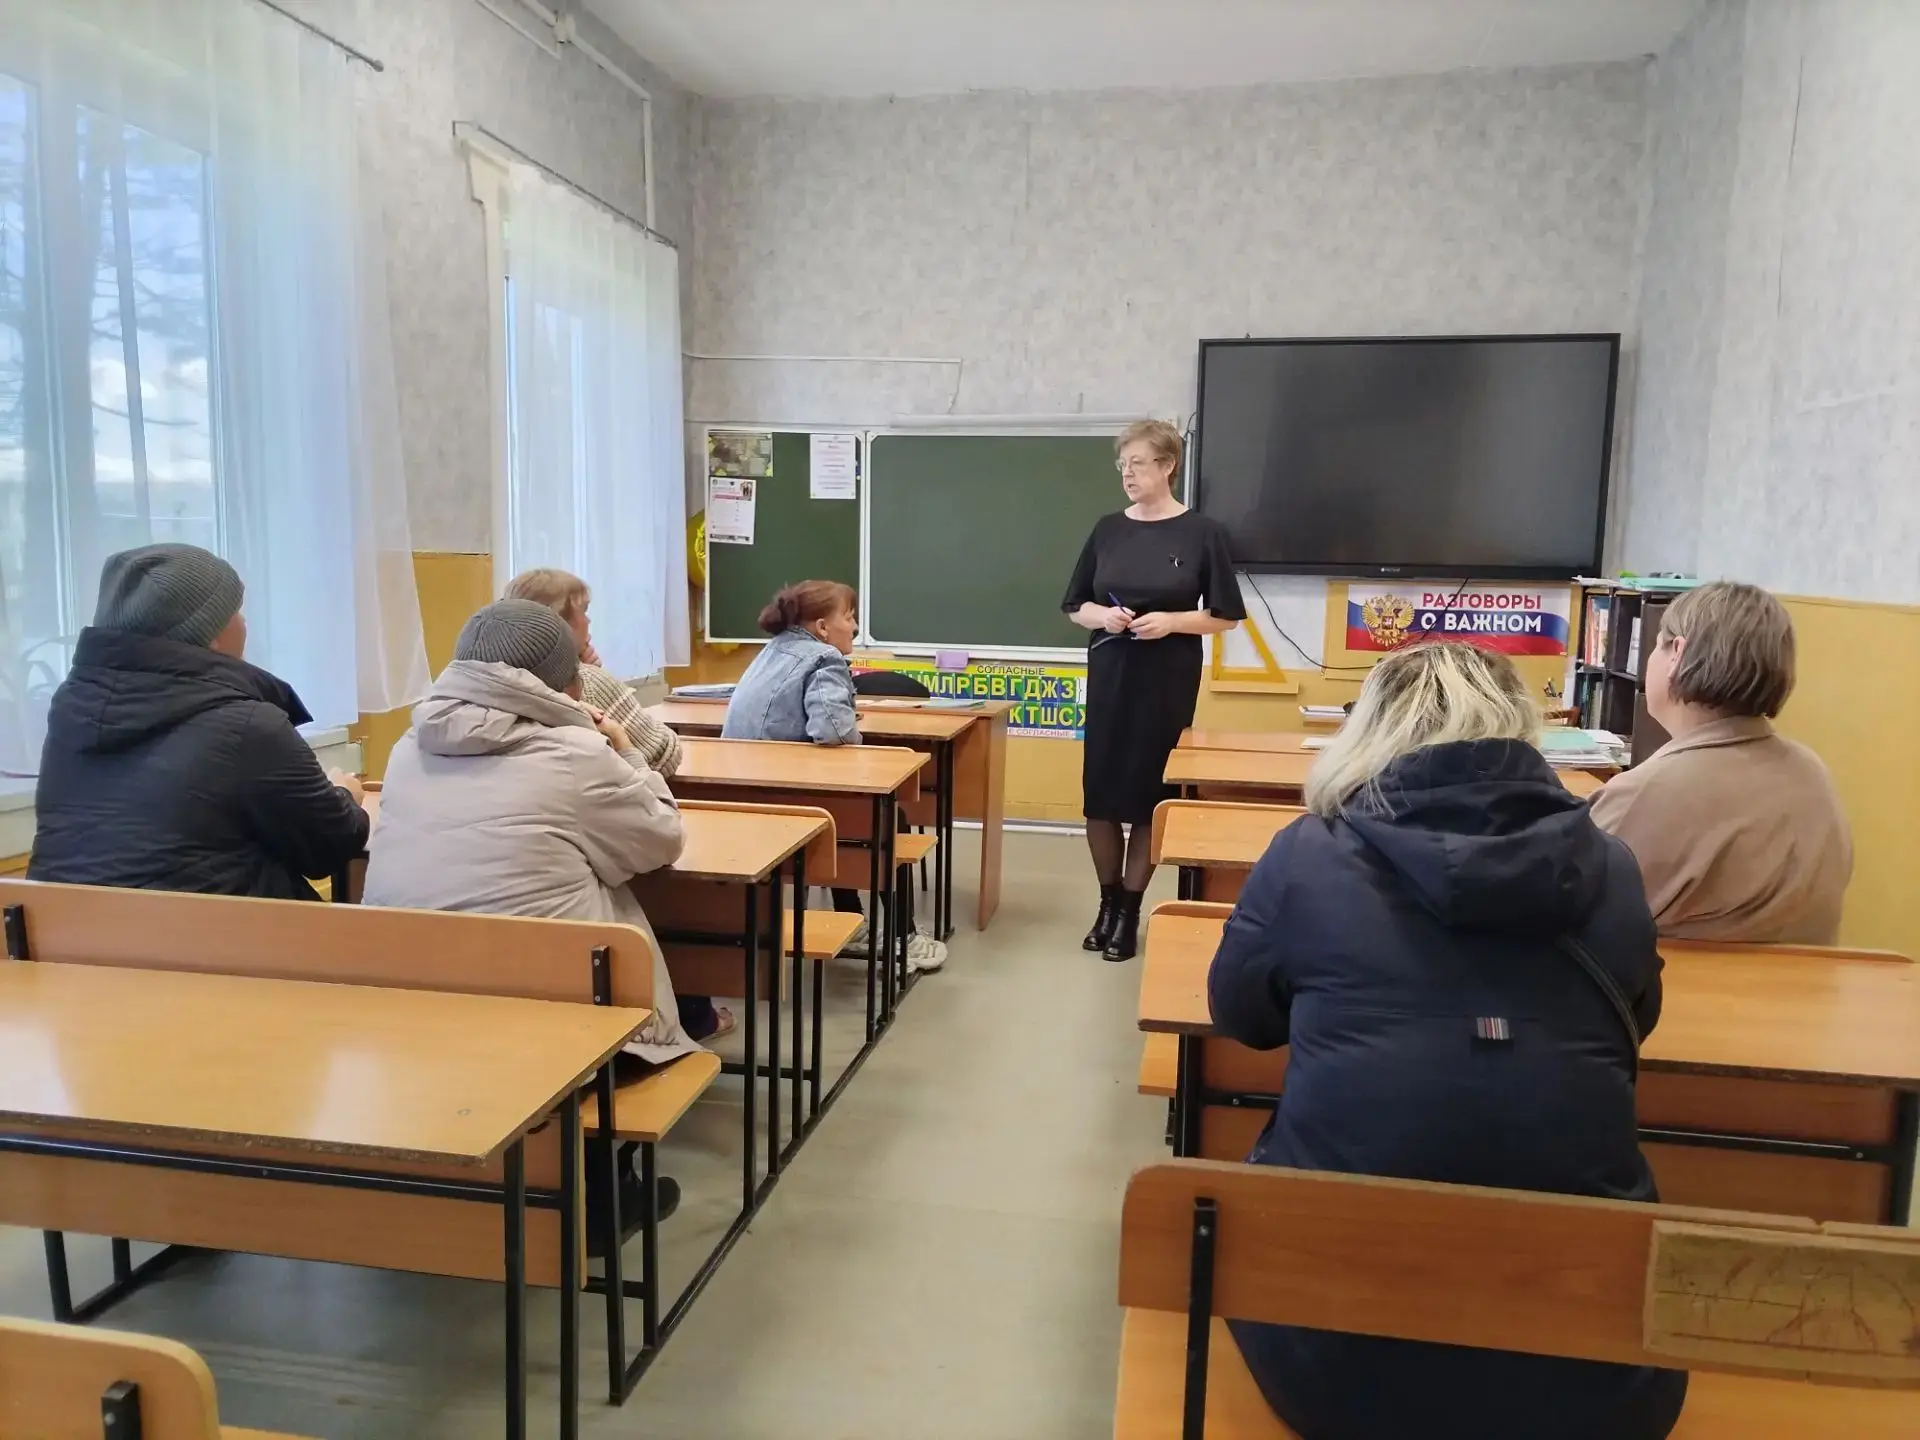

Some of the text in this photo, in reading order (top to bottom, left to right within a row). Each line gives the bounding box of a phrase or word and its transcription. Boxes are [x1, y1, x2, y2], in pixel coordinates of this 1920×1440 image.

[1422, 592, 1542, 610] РАЗГОВОРЫ
[1420, 612, 1542, 633] О ВАЖНОМ
[976, 665, 1045, 676] СОГЛАСНЫЕ
